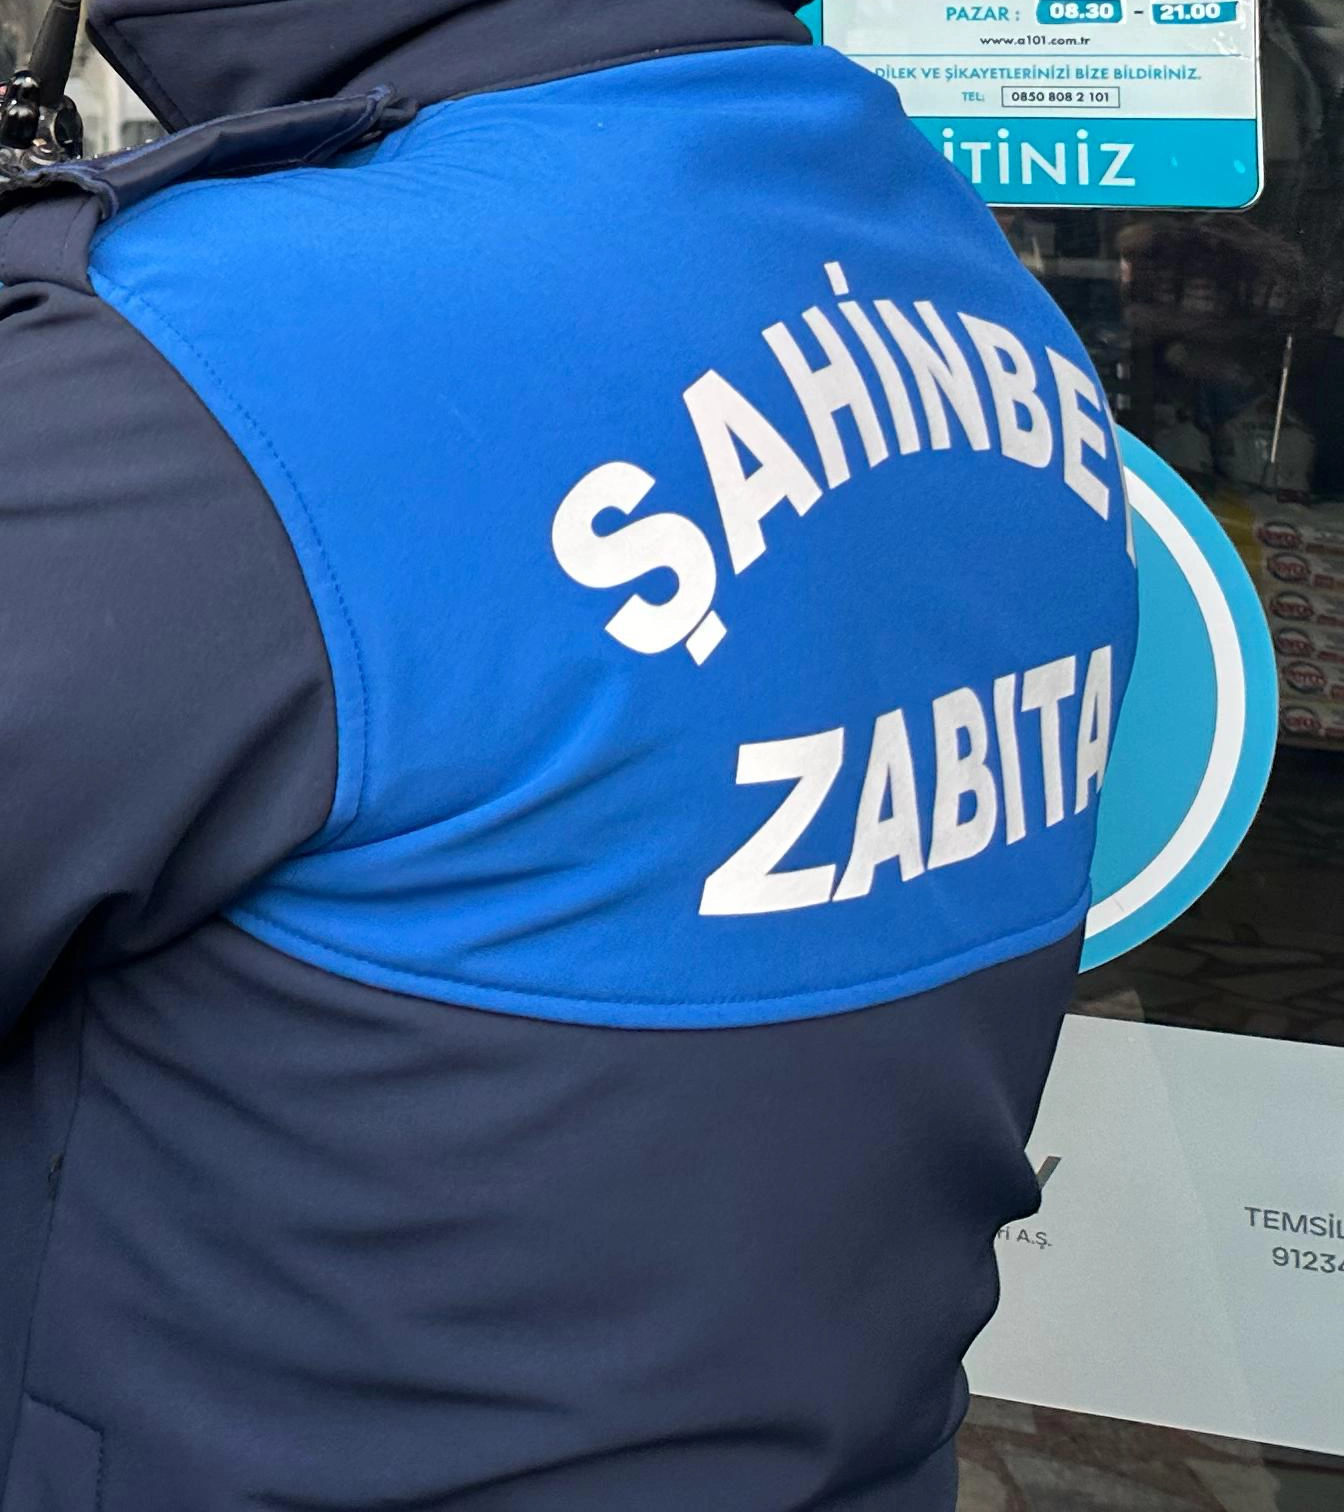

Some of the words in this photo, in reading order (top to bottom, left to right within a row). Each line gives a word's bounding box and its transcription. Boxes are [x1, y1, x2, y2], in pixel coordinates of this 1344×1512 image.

[945, 6, 1010, 21] PAZAR
[1049, 2, 1115, 19] 08.30
[1160, 3, 1221, 20] 21.00
[980, 35, 1091, 46] www.a101.com.tr
[875, 64, 917, 80] DİLEK
[920, 67, 941, 79] VE
[944, 64, 1071, 82] ŞİKAYETLERİNİZİ
[1075, 64, 1110, 80] BİZE
[1113, 64, 1202, 80] BİLDİRİNİZ.
[1011, 91, 1045, 102] 0850
[1048, 91, 1073, 102] 808
[1076, 91, 1084, 102] 2
[1089, 91, 1109, 102] 101
[551, 262, 1136, 666] ŞAHİNBE
[698, 644, 1113, 917] ZABITA
[1016, 1228, 1053, 1250] A.Ş.
